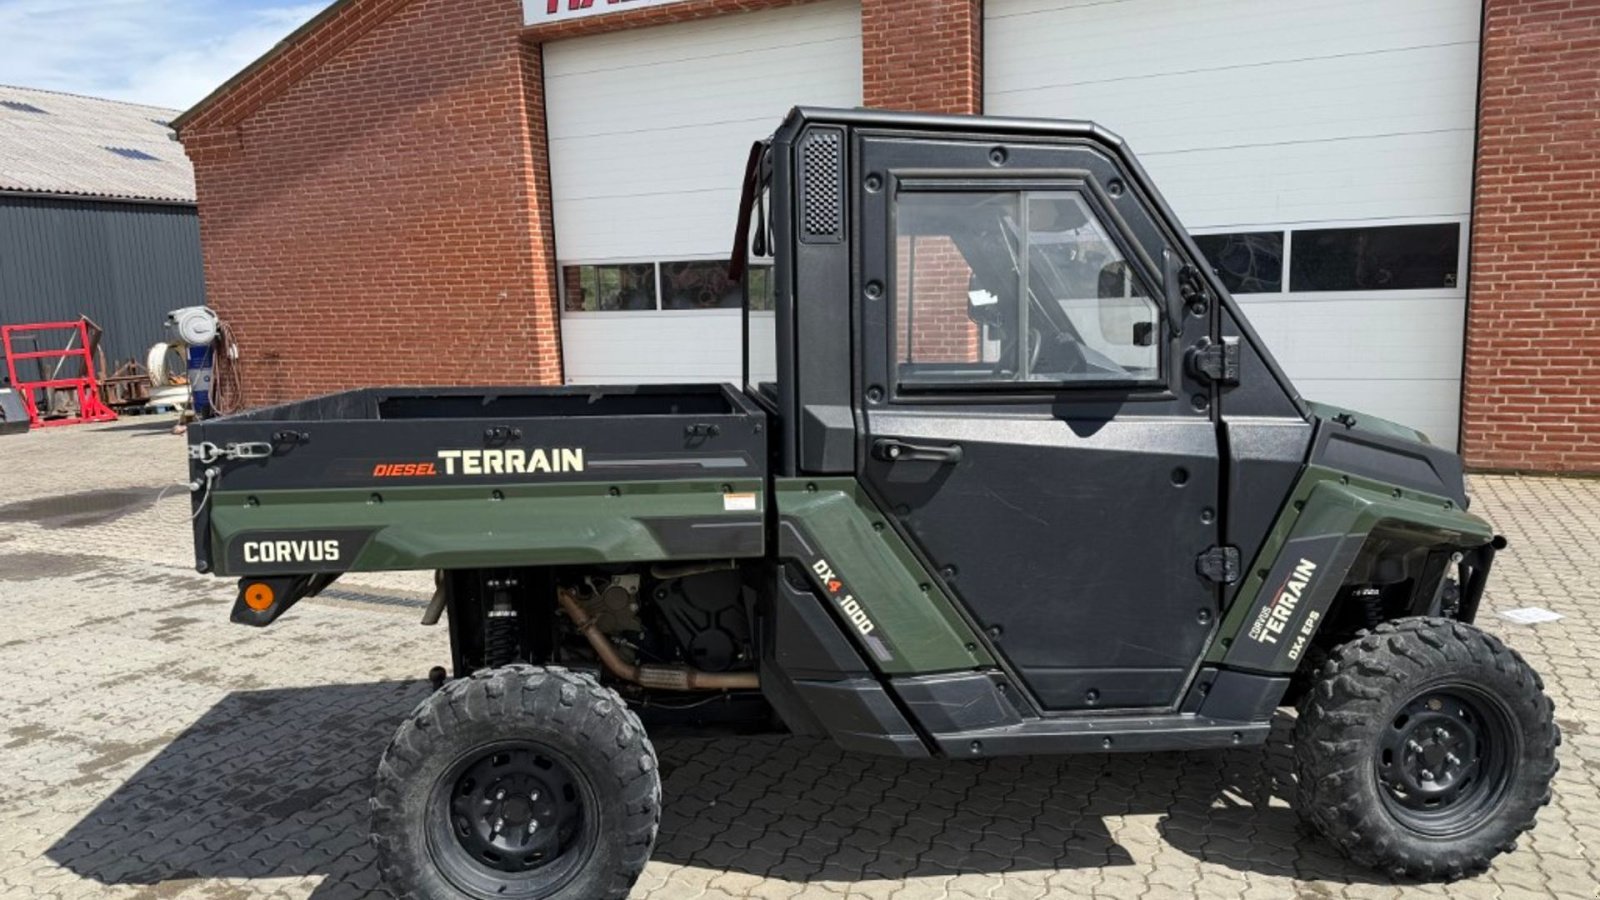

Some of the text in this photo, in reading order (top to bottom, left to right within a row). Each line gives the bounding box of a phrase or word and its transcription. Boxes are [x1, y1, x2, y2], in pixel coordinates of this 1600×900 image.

[373, 448, 584, 477] DIESEL TERRAIN
[243, 540, 340, 563] CORVUS
[812, 559, 875, 635] DX4 1000
[1258, 558, 1317, 644] TERRAIN
[1248, 605, 1272, 640] CORVUS
[1288, 610, 1320, 660] DX4 EPS
